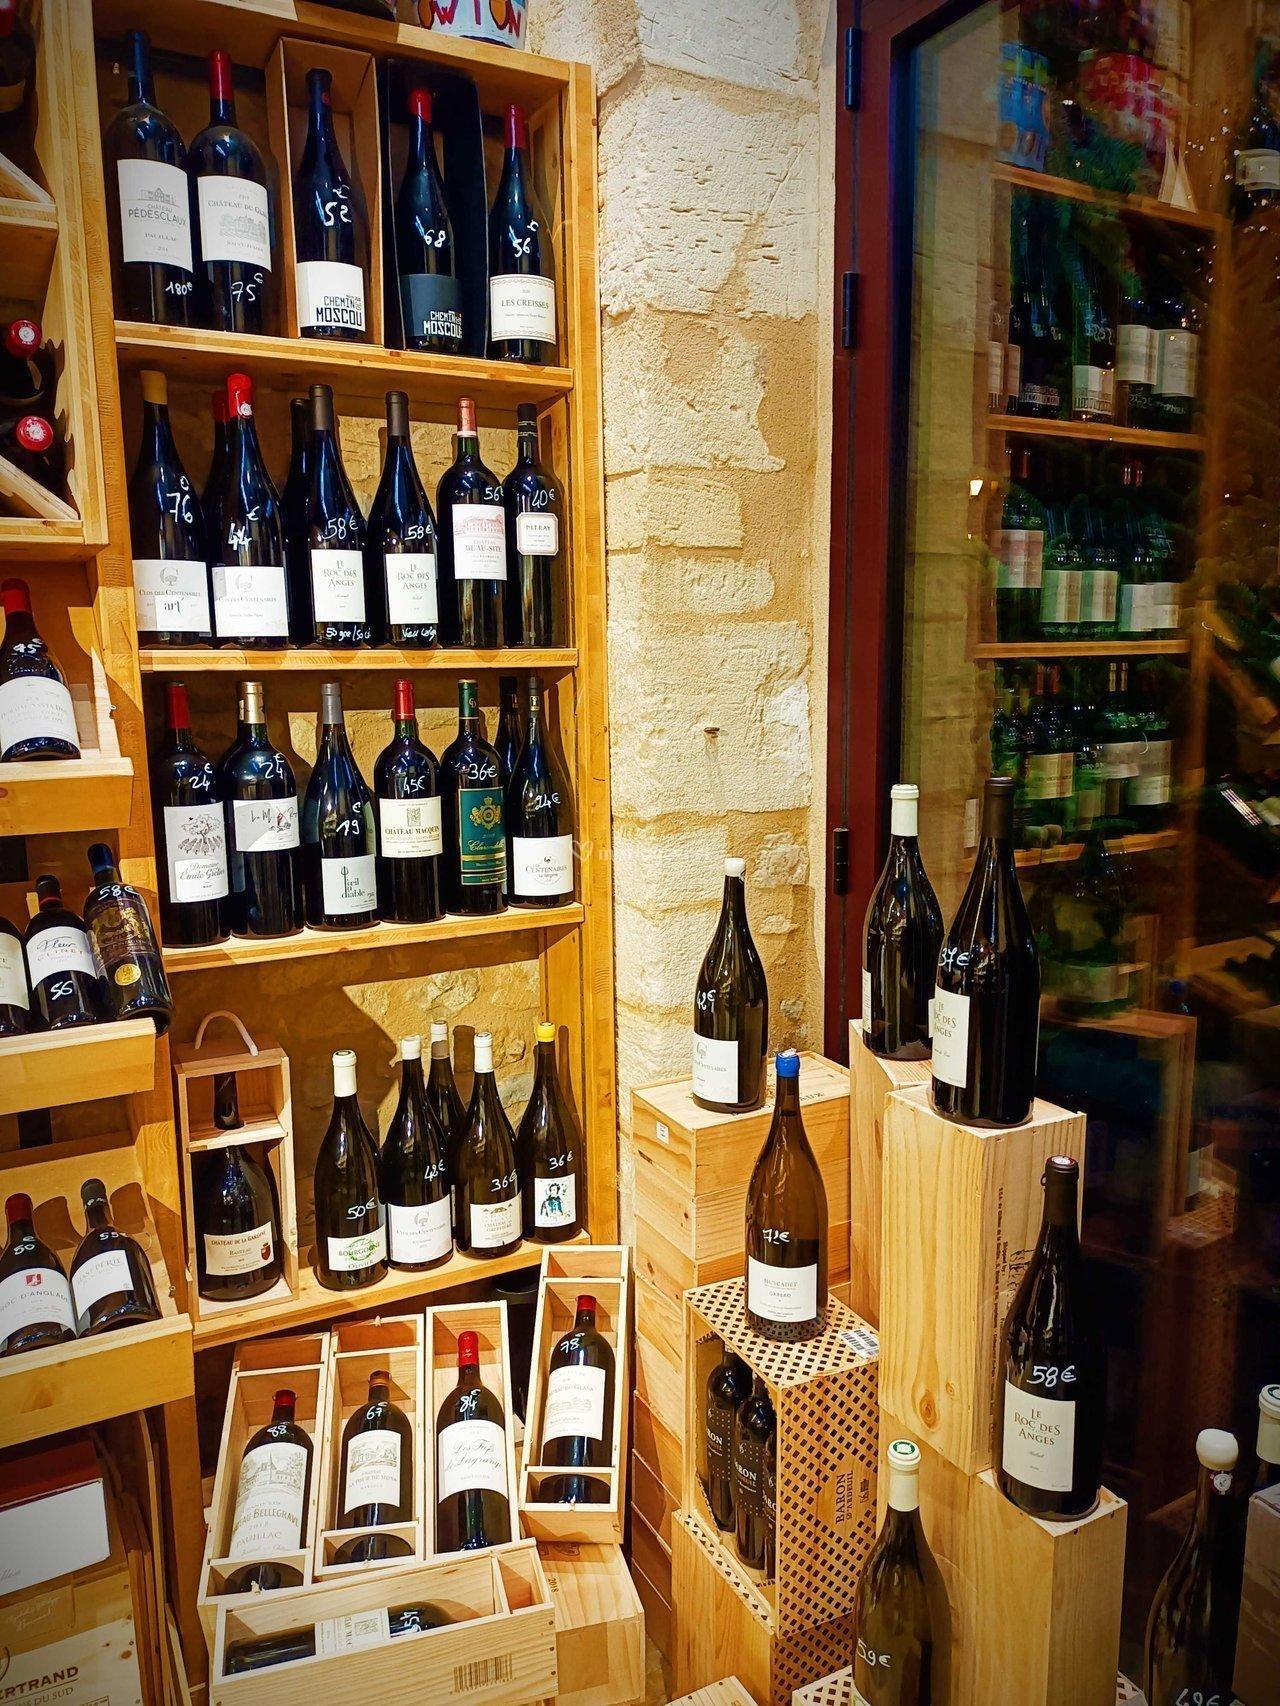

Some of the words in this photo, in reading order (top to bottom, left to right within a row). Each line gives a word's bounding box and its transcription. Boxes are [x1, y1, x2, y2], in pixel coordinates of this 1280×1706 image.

[128, 207, 187, 226] PÉDESCLAUX
[501, 298, 515, 308] LES
[316, 306, 362, 327] MOSCOU
[942, 1013, 957, 1030] DES
[1026, 1365, 1077, 1388] 58€
[1014, 1411, 1036, 1429] ROC
[1039, 1421, 1062, 1436] DES
[1031, 1408, 1042, 1421] LE
[1018, 1428, 1055, 1446] ANGES
[835, 1474, 847, 1524] BARON
[547, 1577, 559, 1593] 2018
